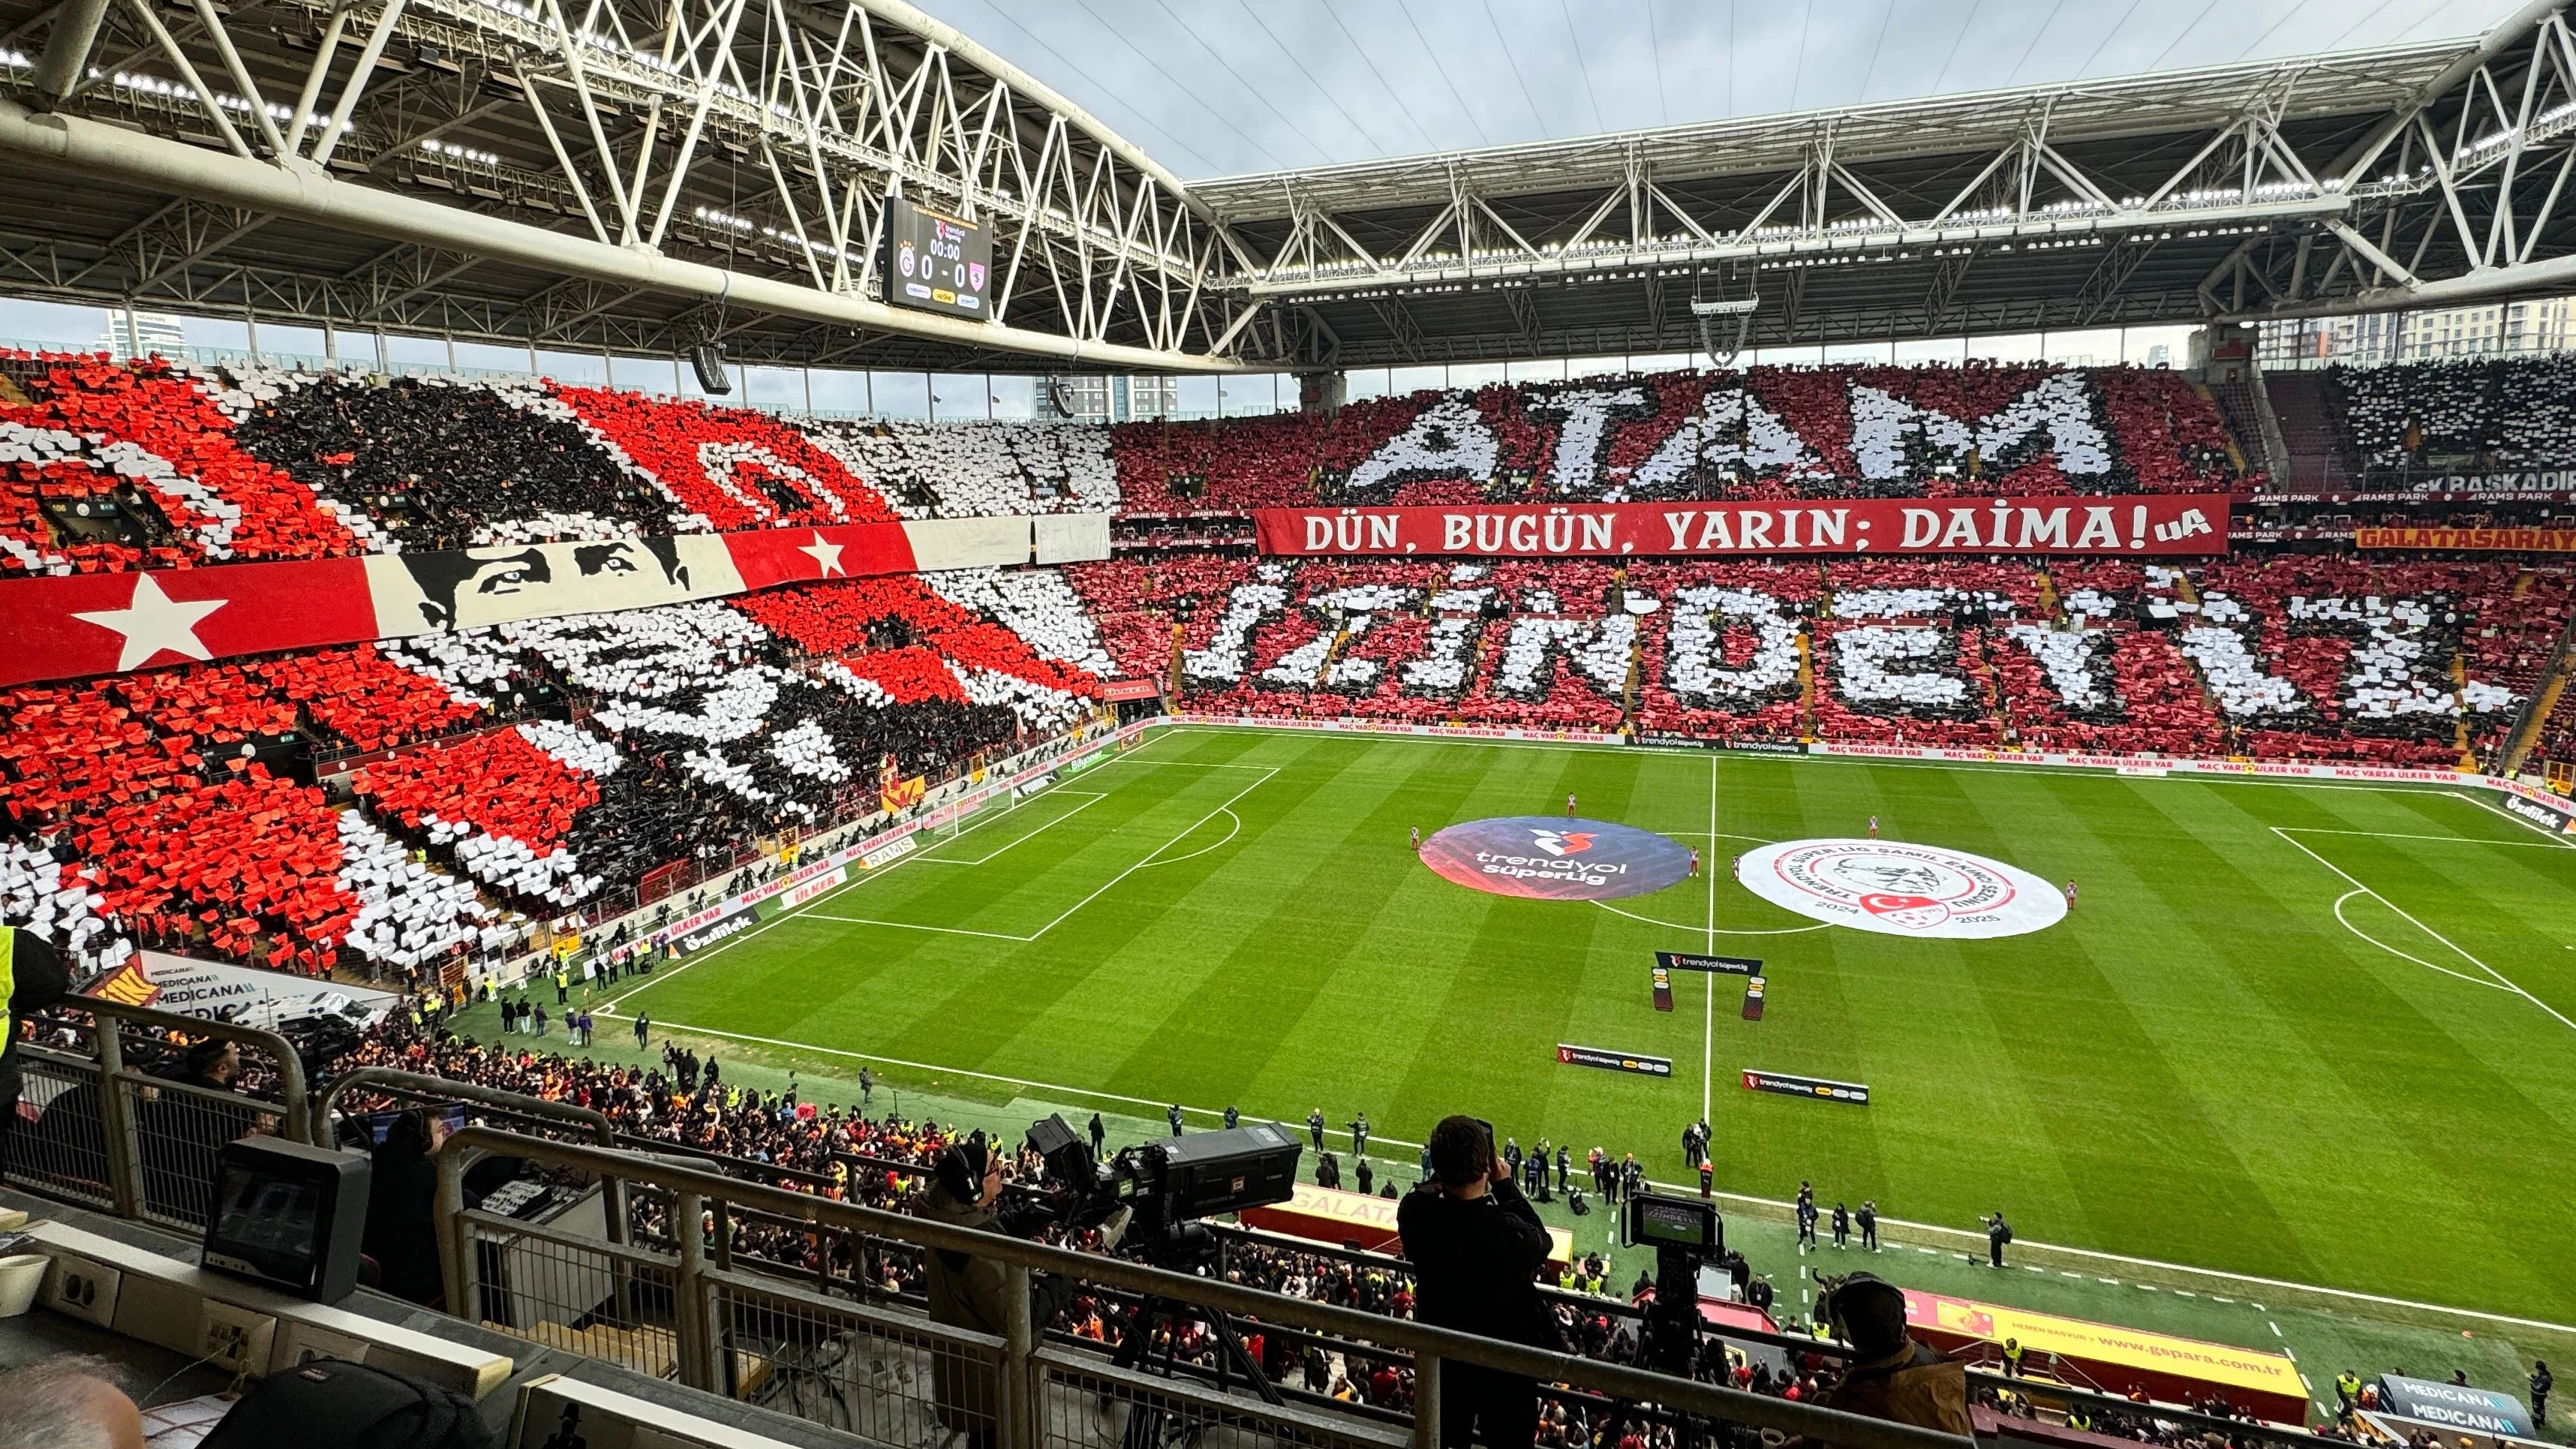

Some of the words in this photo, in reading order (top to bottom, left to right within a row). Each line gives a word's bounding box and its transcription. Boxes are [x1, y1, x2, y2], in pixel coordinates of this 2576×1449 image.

[930, 239, 960, 261] 00:00
[921, 254, 933, 280] 0
[954, 263, 965, 288] 0
[1346, 371, 2112, 489] ATAM
[1303, 508, 1417, 554] DÜN,
[1443, 507, 1634, 555] BUGÜN,
[1663, 509, 1871, 552] YARIN;
[1900, 499, 2148, 550] DAİMA!
[2361, 528, 2576, 551] GALATASARAY
[1641, 737, 1678, 747] trendyol
[1733, 741, 1771, 750] trendyol
[1827, 745, 1847, 754] MAÇ
[1848, 747, 1875, 755] VARSA
[1071, 750, 1103, 771] Bilyoner
[1943, 751, 1963, 761] MAÇ
[2067, 757, 2087, 766] MAÇ
[2091, 758, 2121, 766] VARSA
[2197, 762, 2219, 772] MAÇ
[1020, 776, 1051, 796] PUMA
[2335, 768, 2360, 779] MAÇ
[2362, 770, 2394, 779] VARSA
[2397, 768, 2431, 780] ÜLKER
[2435, 772, 2457, 782] VAR
[2506, 795, 2561, 829] Özdilek
[2556, 798, 2571, 811] VAR
[868, 837, 915, 866] RAMS
[1476, 852, 1628, 874] trendyol
[741, 888, 762, 906] MAÇ
[790, 864, 814, 882] ÜLKER
[815, 860, 831, 874] VAR
[794, 875, 837, 903] ÜLKER
[1952, 885, 1999, 908] SEZONU
[703, 907, 722, 922] VAR
[1814, 900, 1859, 915] 2024
[1955, 915, 2002, 924] 2025
[684, 915, 753, 951] Özdilek
[151, 967, 189, 977] MEDICANA
[1682, 958, 1718, 968] trendyol
[153, 975, 212, 989] MEDICANA
[158, 985, 245, 1005] MEDICANA
[2012, 1322, 2045, 1333] HEMEN
[2098, 1335, 2283, 1377] www.gspara.com.tr
[2402, 1381, 2496, 1408] MEDICANA
[2411, 1402, 2505, 1433] MEDICANA
